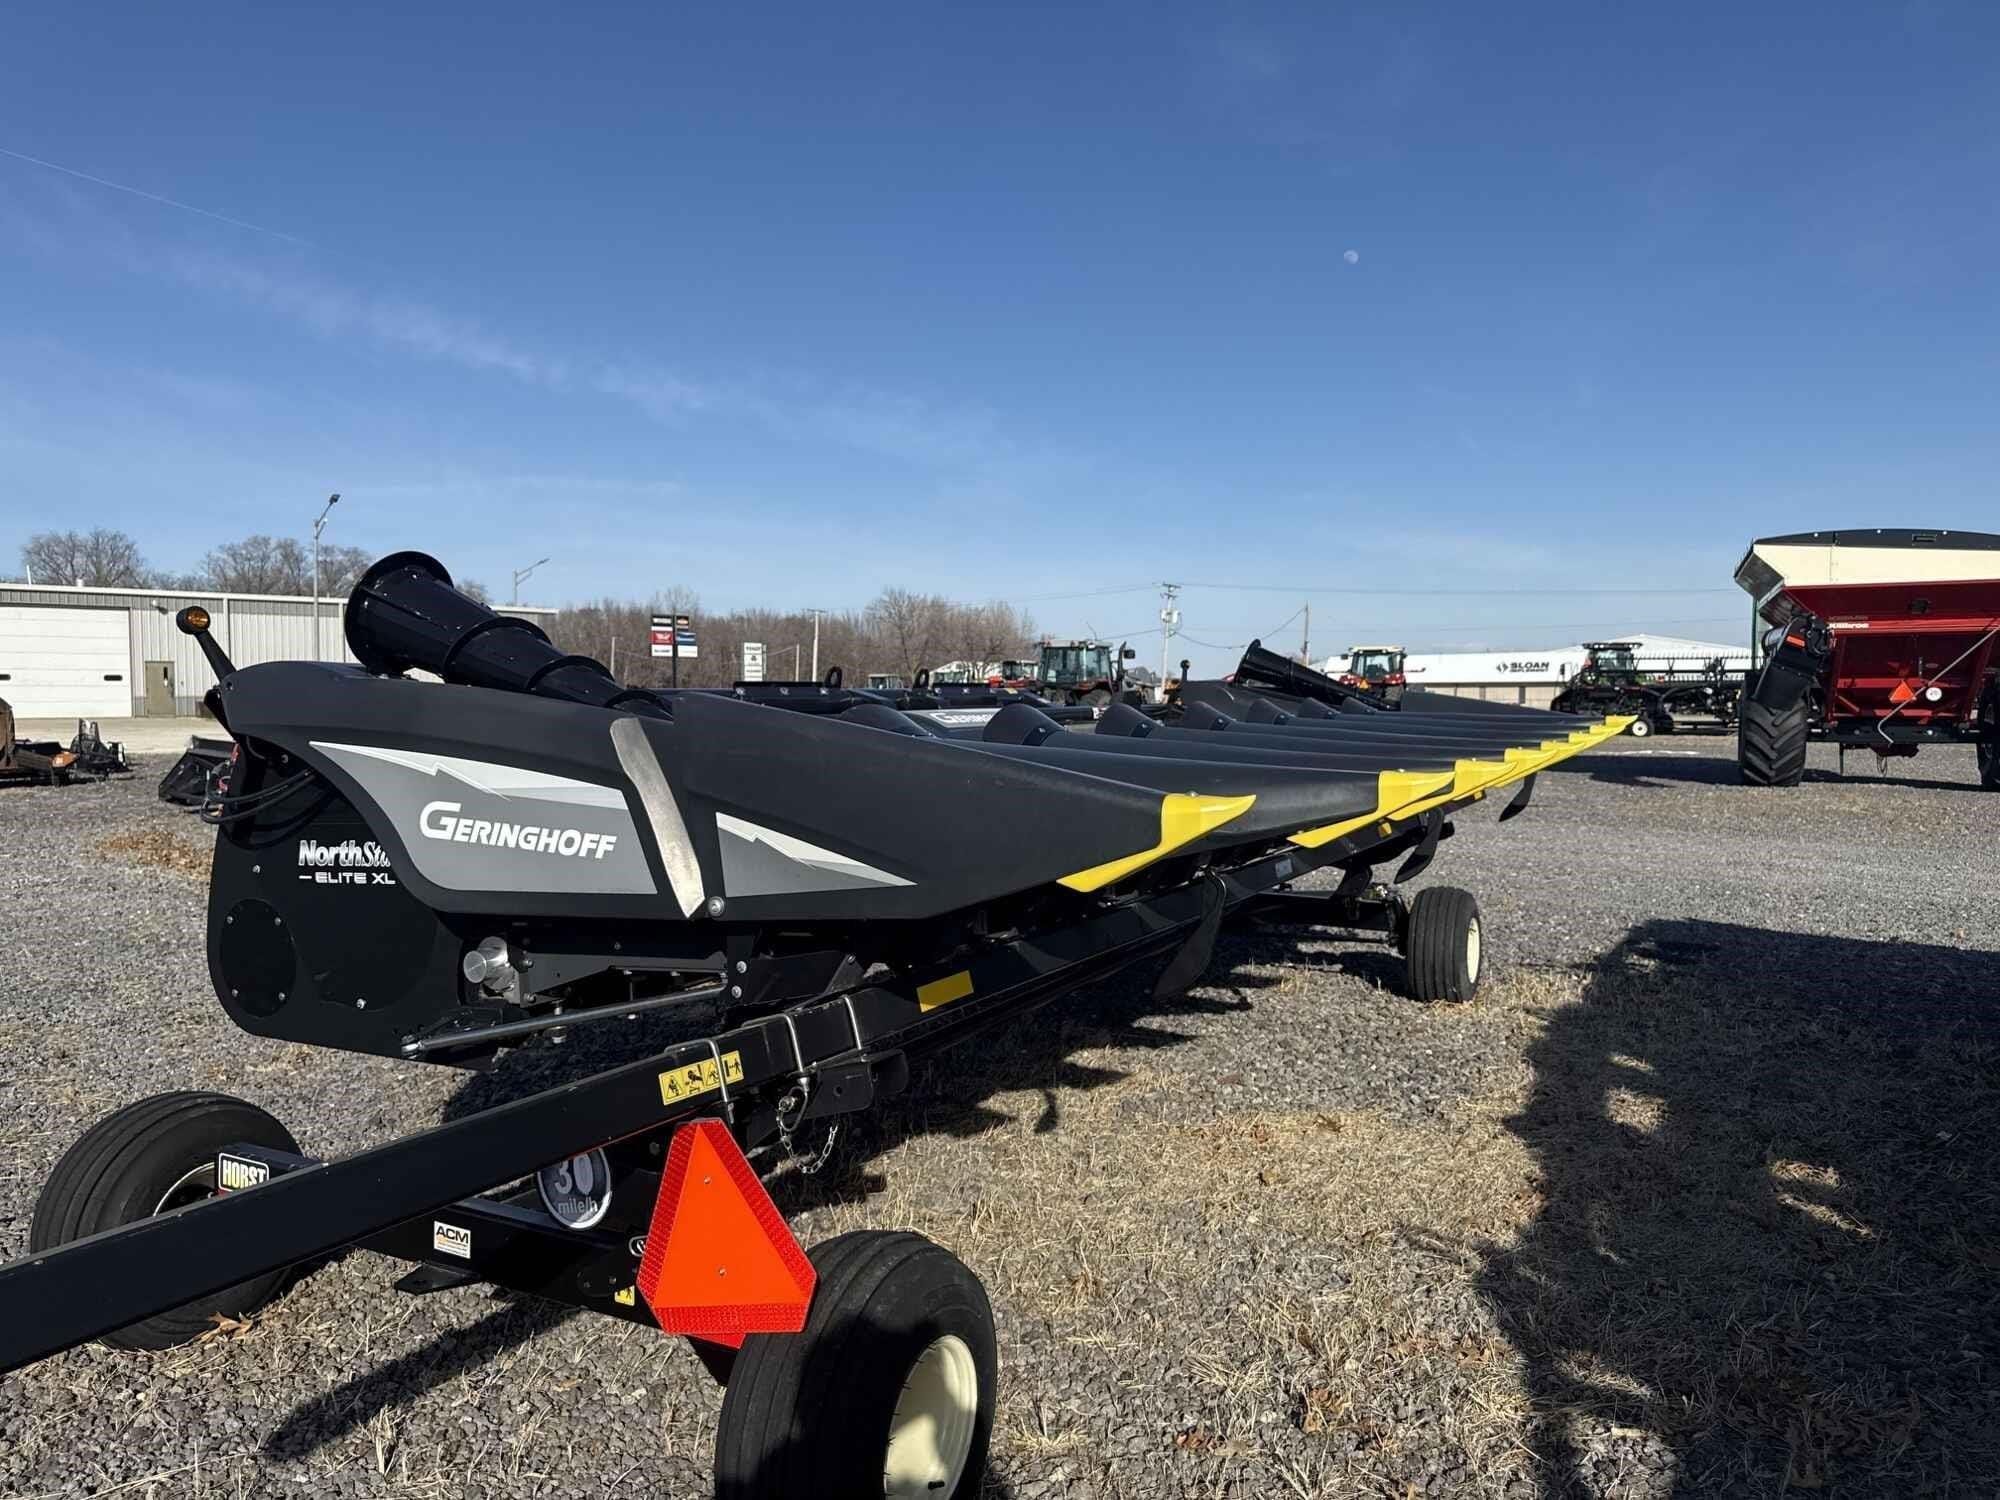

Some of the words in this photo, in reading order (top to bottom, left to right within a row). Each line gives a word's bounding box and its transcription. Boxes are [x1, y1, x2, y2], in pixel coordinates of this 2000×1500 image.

[418, 800, 617, 860] GERINGHOFF
[315, 872, 367, 885] ELITE
[372, 873, 396, 885] XL
[222, 1159, 266, 1189] HORST
[554, 1153, 594, 1197] 30
[436, 1225, 469, 1244] ACM
